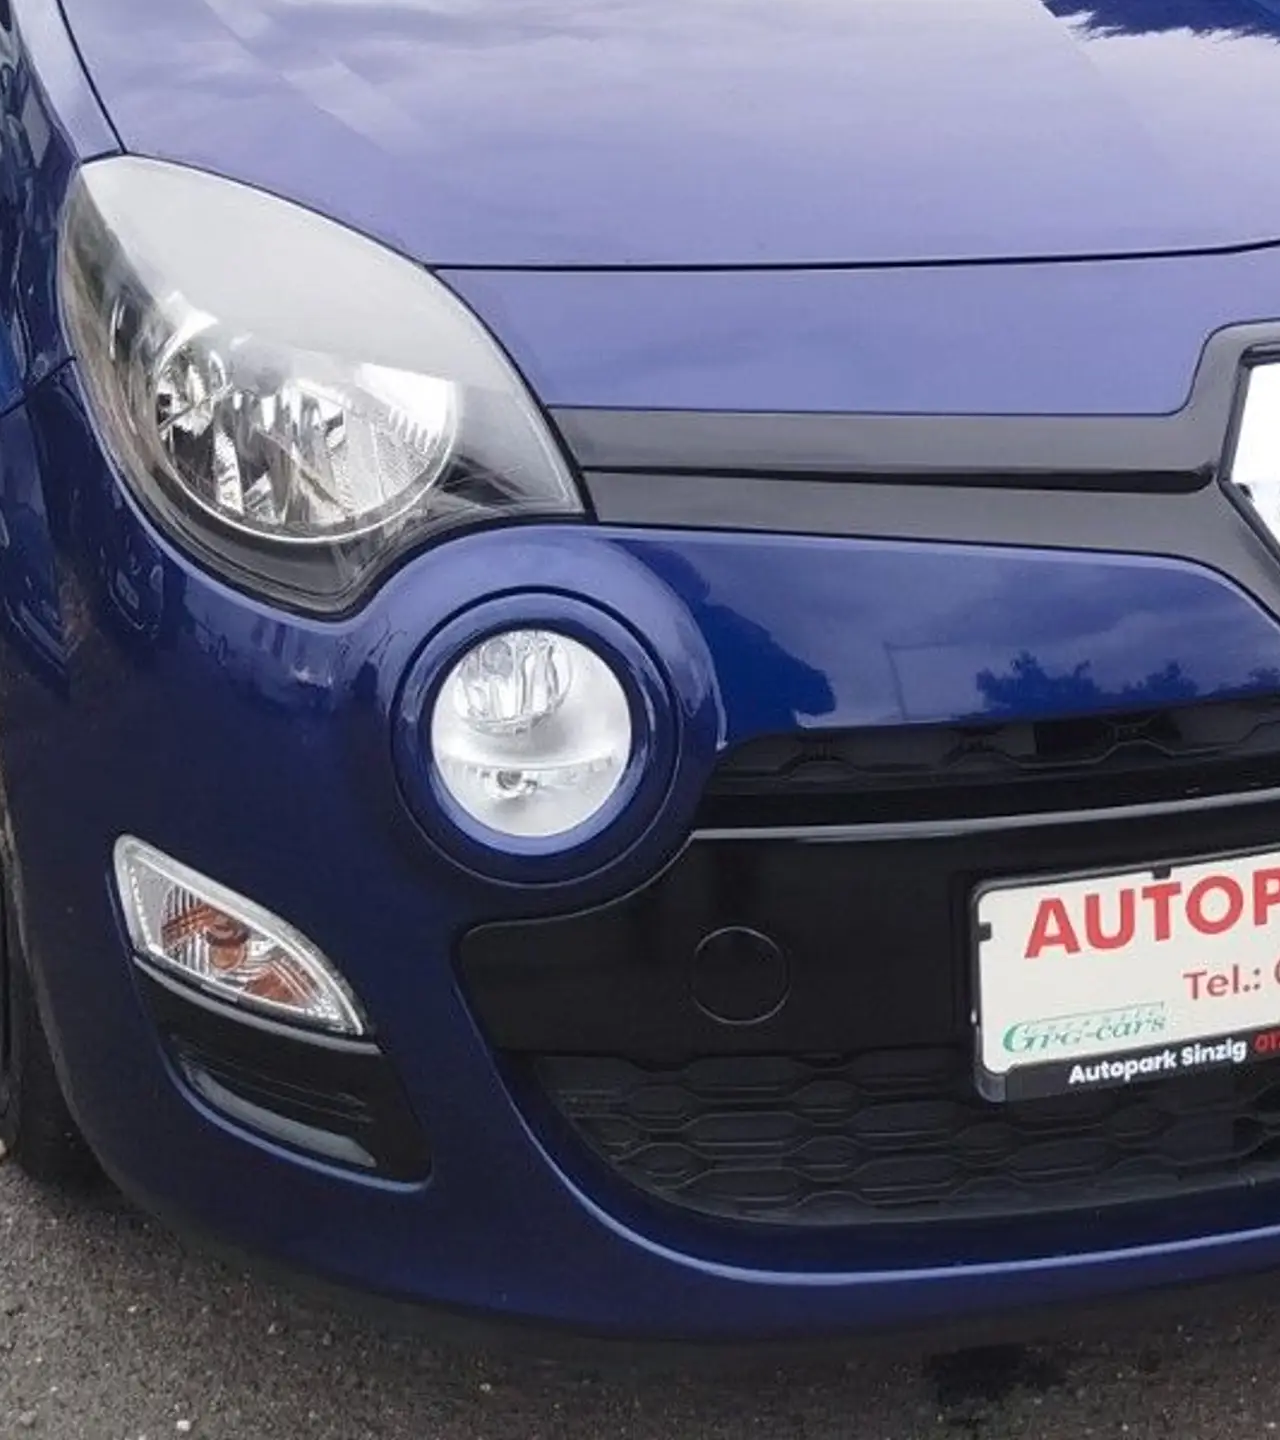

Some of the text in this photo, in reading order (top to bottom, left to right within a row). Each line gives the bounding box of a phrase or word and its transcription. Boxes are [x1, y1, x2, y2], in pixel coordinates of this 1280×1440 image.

[1182, 963, 1262, 1001] Tel.:
[1068, 1048, 1178, 1085] Autopark
[1180, 1037, 1248, 1066] Sinzig
